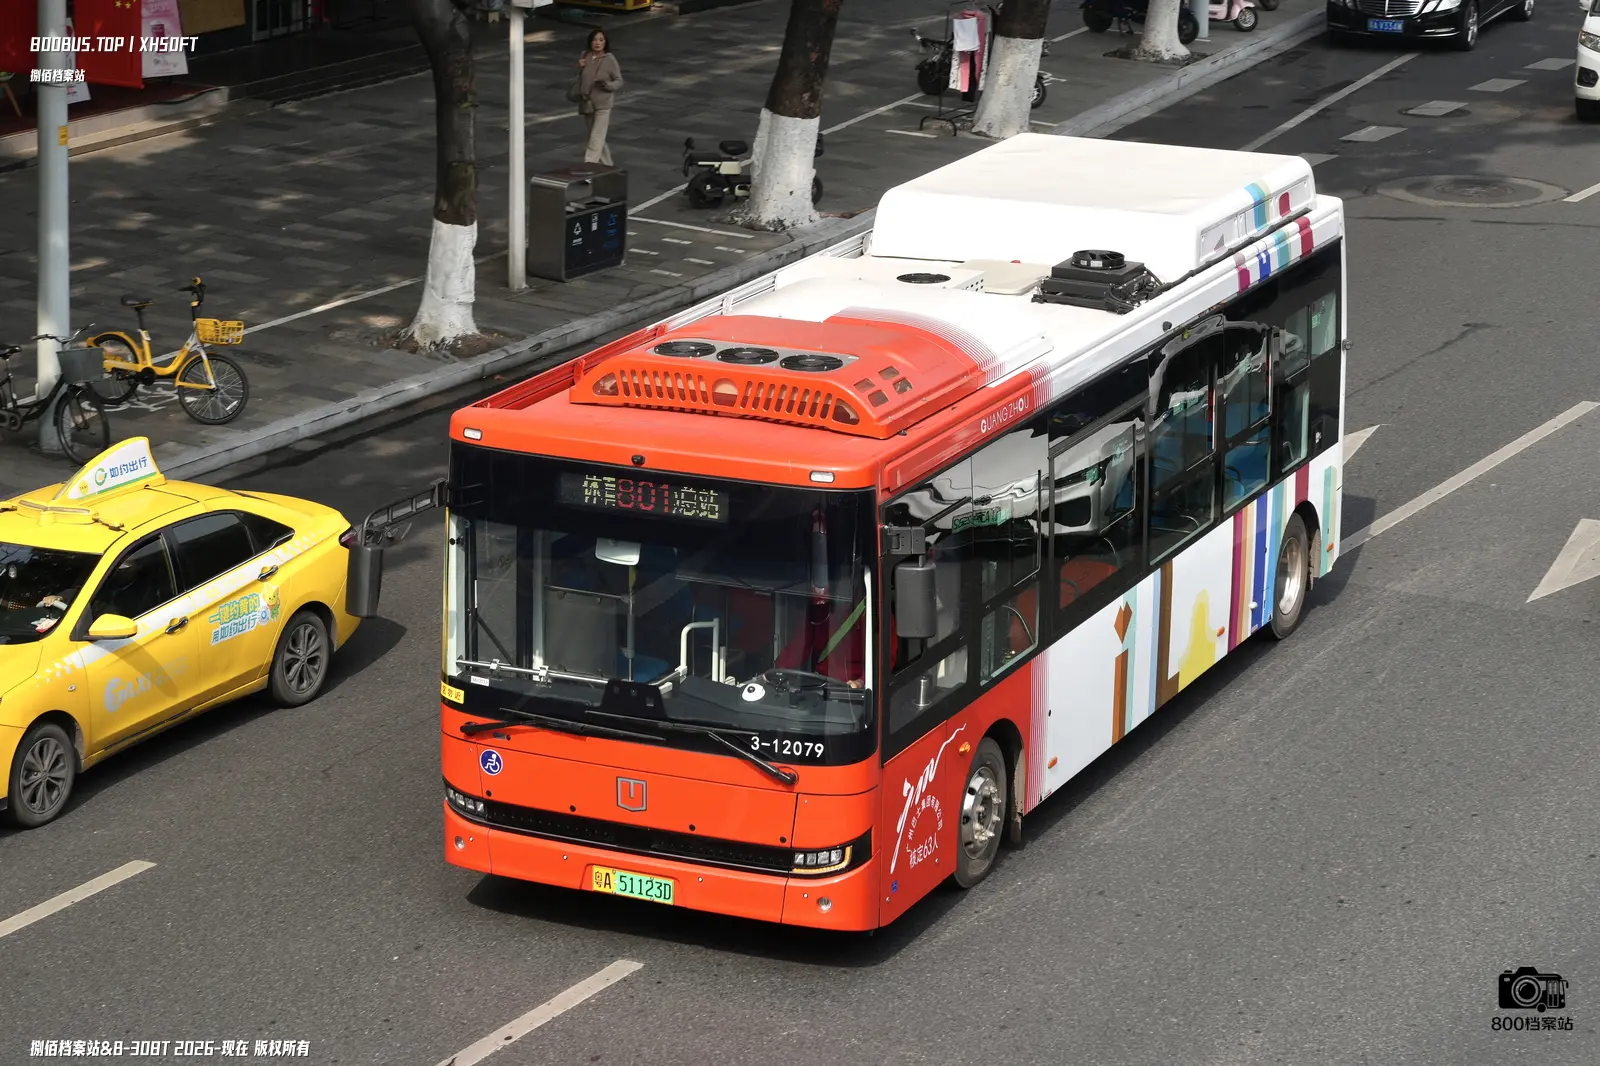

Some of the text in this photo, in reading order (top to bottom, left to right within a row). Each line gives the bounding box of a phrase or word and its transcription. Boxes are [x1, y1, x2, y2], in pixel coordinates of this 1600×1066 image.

[980, 393, 1030, 434] GUANGZHOU
[109, 456, 148, 479] 如约出行
[211, 613, 258, 644] 用如约出行
[750, 735, 825, 758] 3-12079
[909, 832, 939, 869] 核定63人
[619, 875, 672, 900] 51123D
